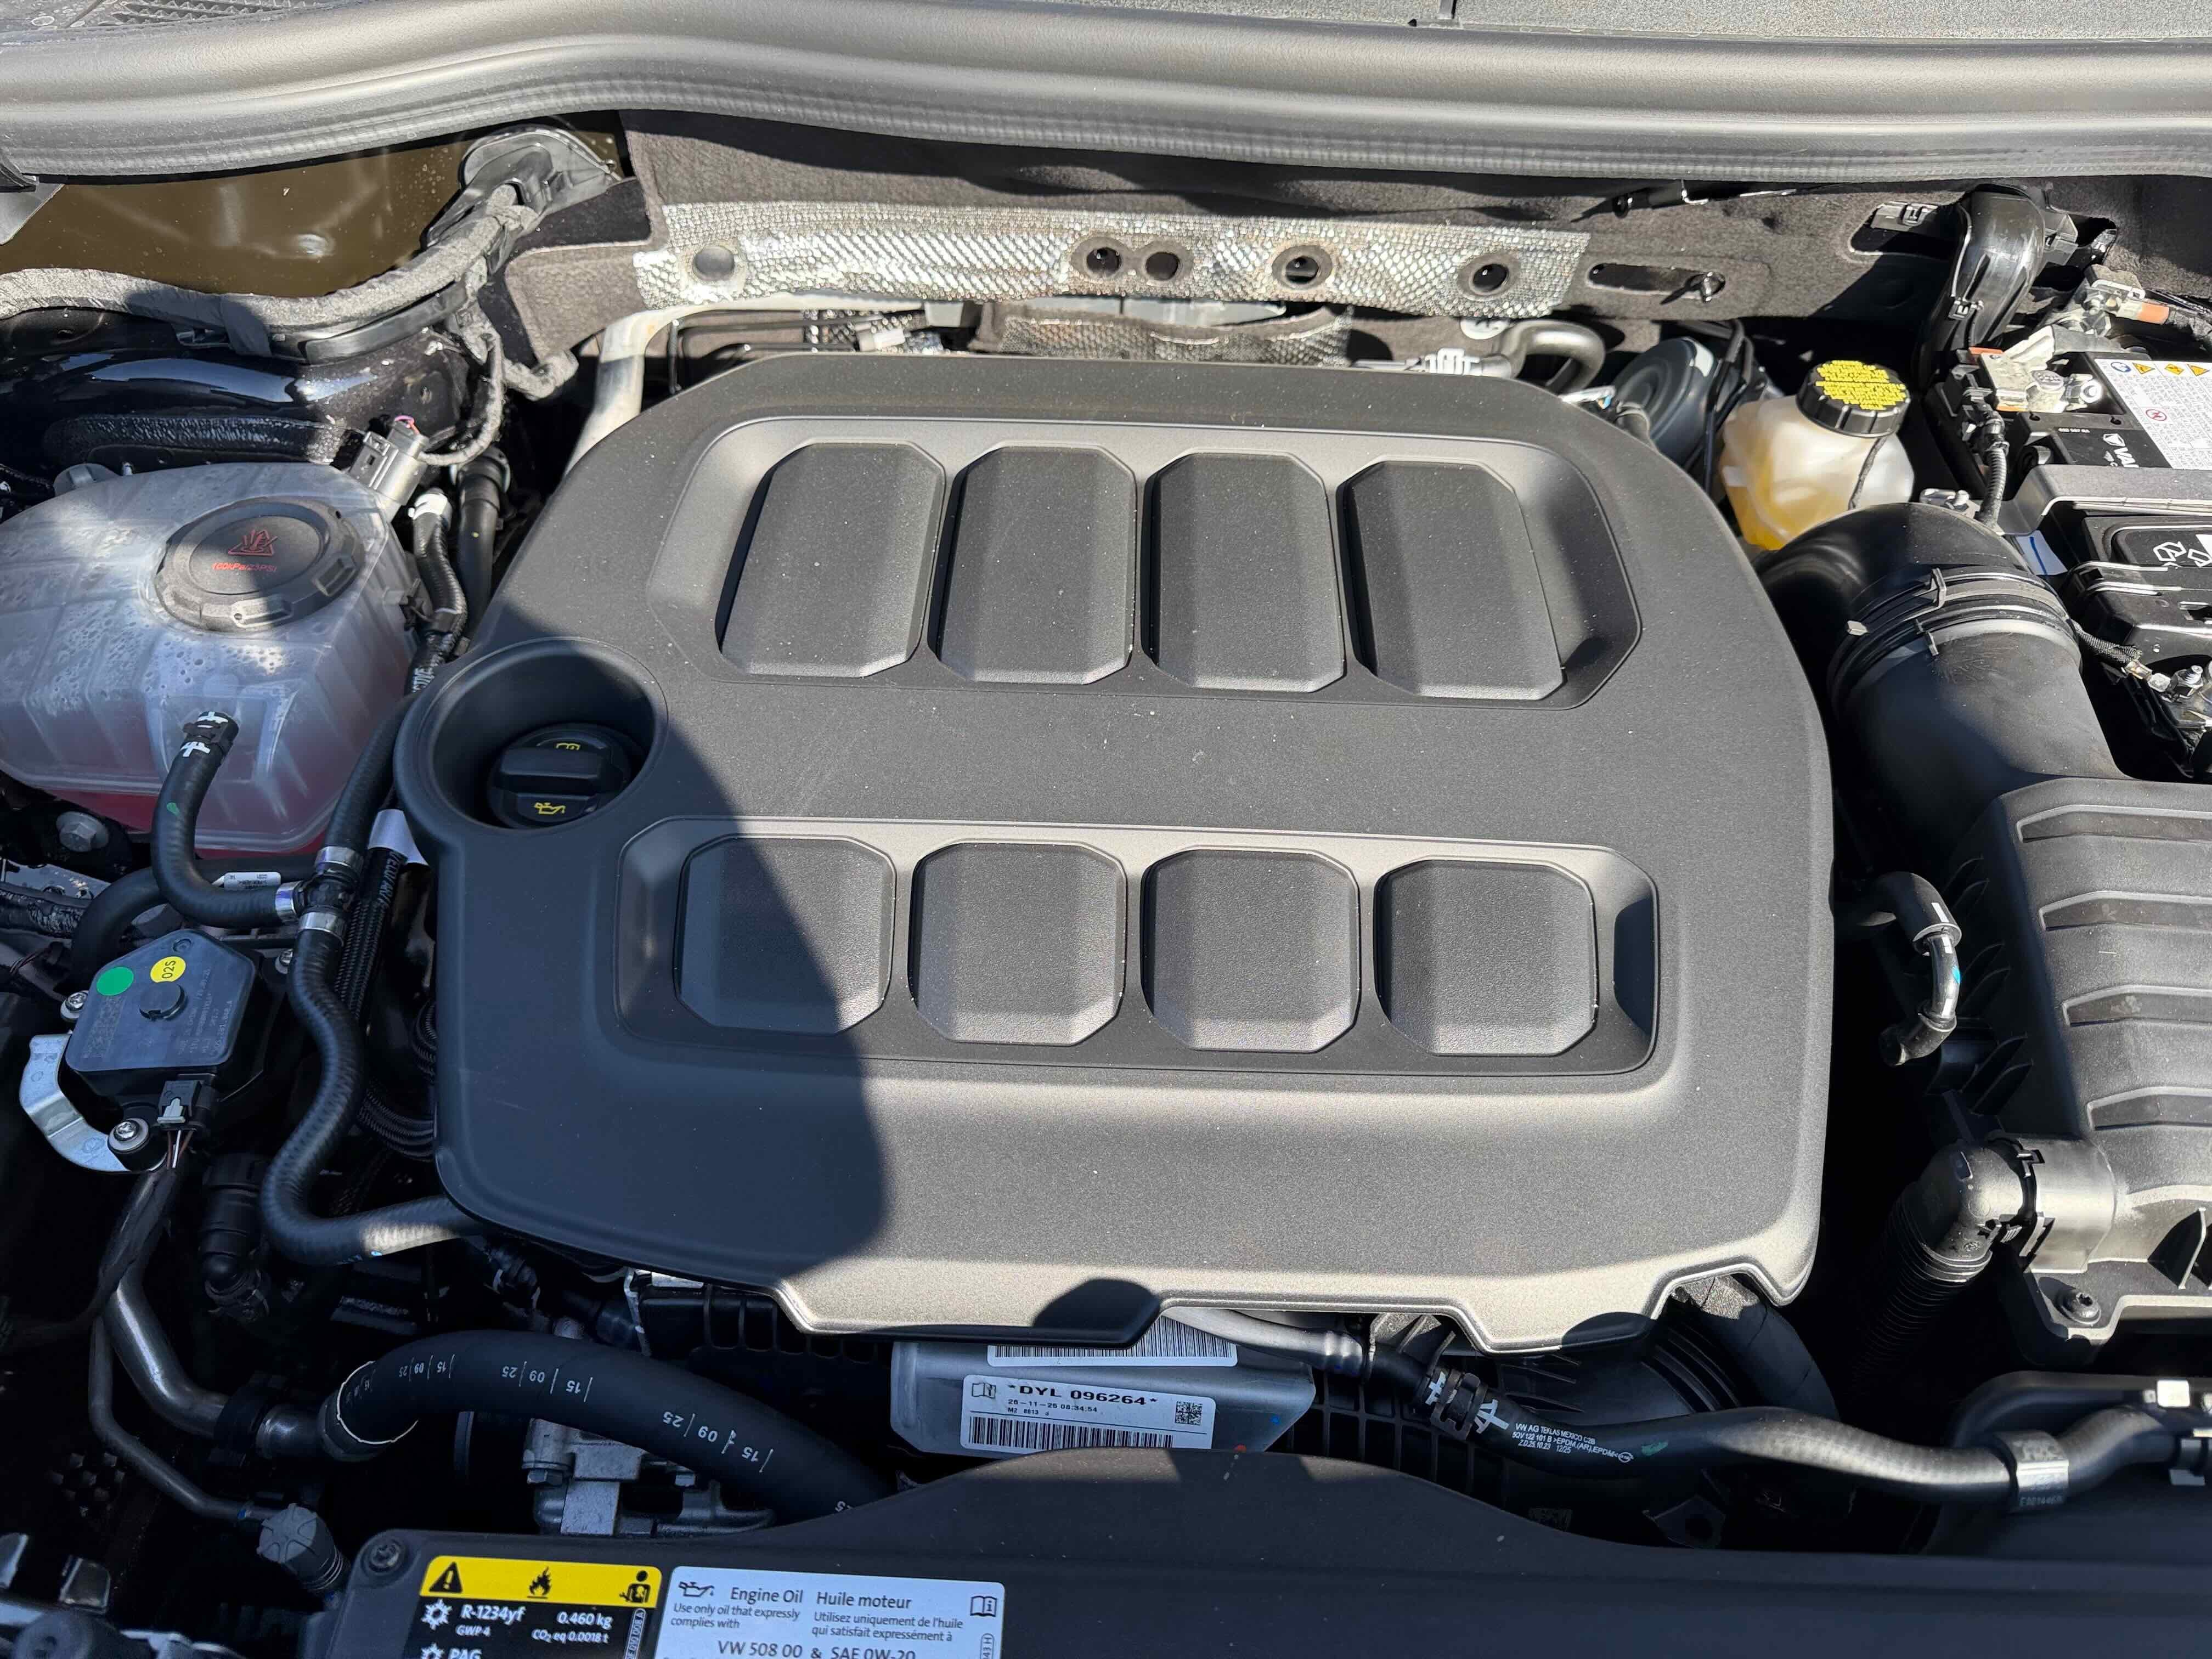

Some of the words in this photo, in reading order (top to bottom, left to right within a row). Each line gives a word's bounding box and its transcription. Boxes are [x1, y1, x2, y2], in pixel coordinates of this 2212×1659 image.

[501, 1366, 518, 1379] 25
[529, 1370, 545, 1383] 09
[663, 1411, 684, 1428] 25
[698, 1426, 719, 1442] 09
[1515, 1423, 1528, 1431] VW
[1541, 1426, 1560, 1436] TEKLAS
[1560, 1430, 1582, 1442] MEXICO
[730, 1587, 780, 1605] Engine
[783, 1589, 804, 1604] Oil
[816, 1592, 856, 1606] Huile
[858, 1596, 912, 1609] moteur
[461, 1604, 526, 1626] R-1234yf
[674, 1602, 692, 1613] Use
[694, 1604, 715, 1616] only
[717, 1605, 730, 1615] oil
[731, 1606, 752, 1616] that
[754, 1608, 800, 1621] expressly
[814, 1611, 850, 1623] Utilisez
[853, 1613, 915, 1628] uniquement
[917, 1616, 930, 1627] de
[933, 1616, 963, 1629] l'huile
[557, 1611, 595, 1625] 0.460
[596, 1613, 613, 1630] kg
[670, 1617, 715, 1629] complies
[717, 1619, 740, 1629] with
[456, 1624, 482, 1636] GWP
[482, 1626, 491, 1637] 4
[553, 1632, 566, 1644] eq
[568, 1630, 602, 1643] 0.0018
[602, 1633, 609, 1644] t
[811, 1626, 828, 1638] qui
[830, 1626, 871, 1638] satisfait
[873, 1629, 944, 1641] expressément
[946, 1632, 952, 1642] à
[718, 1640, 746, 1655] VW
[749, 1641, 778, 1657] 508
[782, 1644, 803, 1658] 00
[810, 1647, 821, 1659] &
[830, 1646, 860, 1659] SAE
